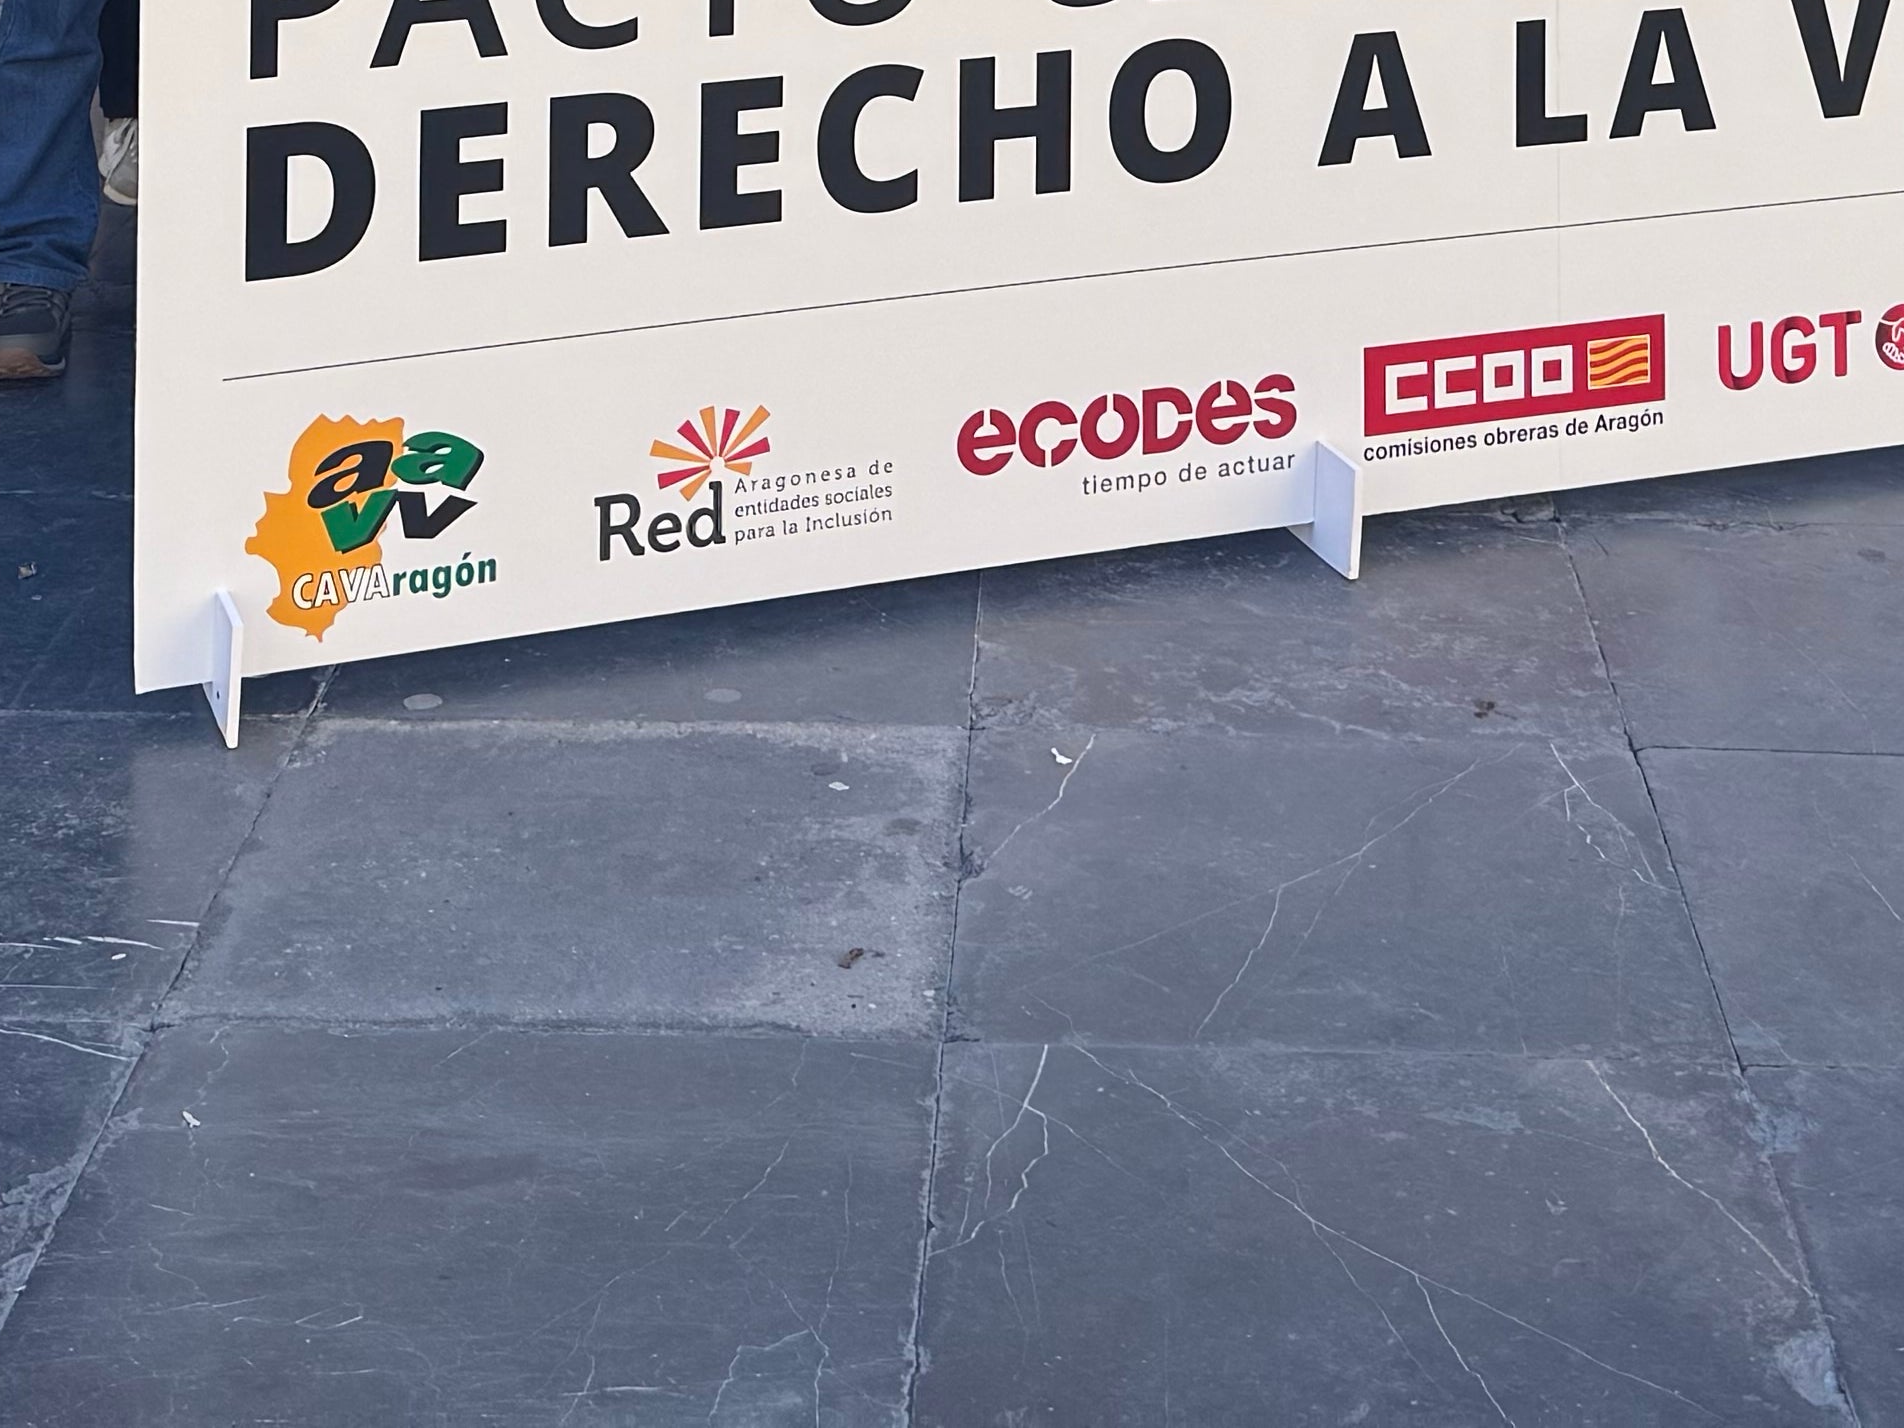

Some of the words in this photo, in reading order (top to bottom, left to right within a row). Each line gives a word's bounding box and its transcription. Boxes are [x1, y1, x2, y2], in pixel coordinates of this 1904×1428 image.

[244, 38, 1232, 283] DERECHO
[1317, 30, 1433, 167] A
[1515, 7, 1717, 148] LA
[1718, 310, 1862, 390] UGT
[1385, 344, 1573, 415] CCOO
[1364, 433, 1477, 462] comisiones
[1484, 423, 1559, 447] obreras
[1565, 418, 1589, 436] de
[1594, 409, 1664, 433] Aragón
[735, 465, 856, 494] Aragonesa
[868, 459, 893, 476] de
[735, 493, 819, 518] entidades
[826, 483, 893, 505] sociales
[1082, 472, 1167, 495] tiempo
[1178, 463, 1207, 483] de
[1218, 453, 1296, 477] actuar
[594, 481, 726, 561] Red
[735, 524, 776, 545] para
[782, 520, 798, 535] la
[805, 508, 893, 533] Inclusión
[291, 552, 497, 610] CAVAragón
